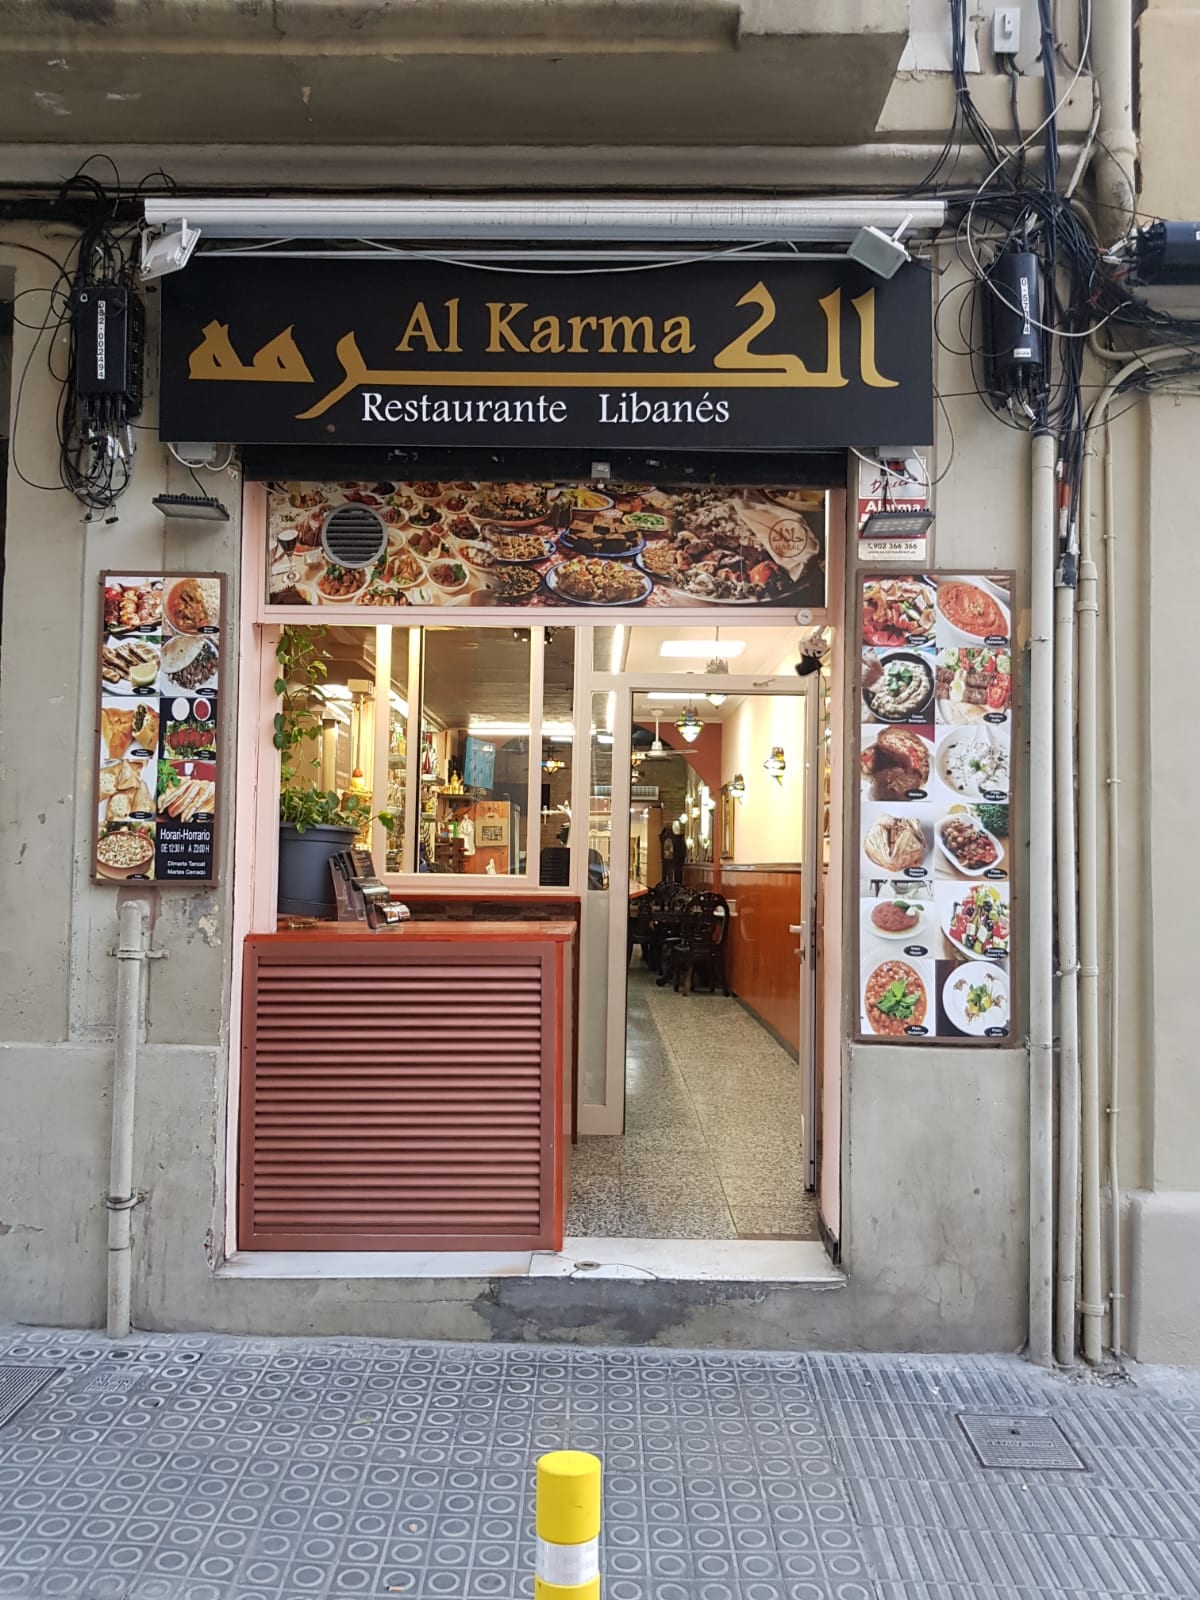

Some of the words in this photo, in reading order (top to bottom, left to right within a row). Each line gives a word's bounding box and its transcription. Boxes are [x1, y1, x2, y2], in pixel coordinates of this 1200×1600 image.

[397, 299, 460, 353] Al
[485, 302, 695, 354] Karma
[361, 393, 568, 423] Restaurante
[599, 392, 730, 424] Libanés
